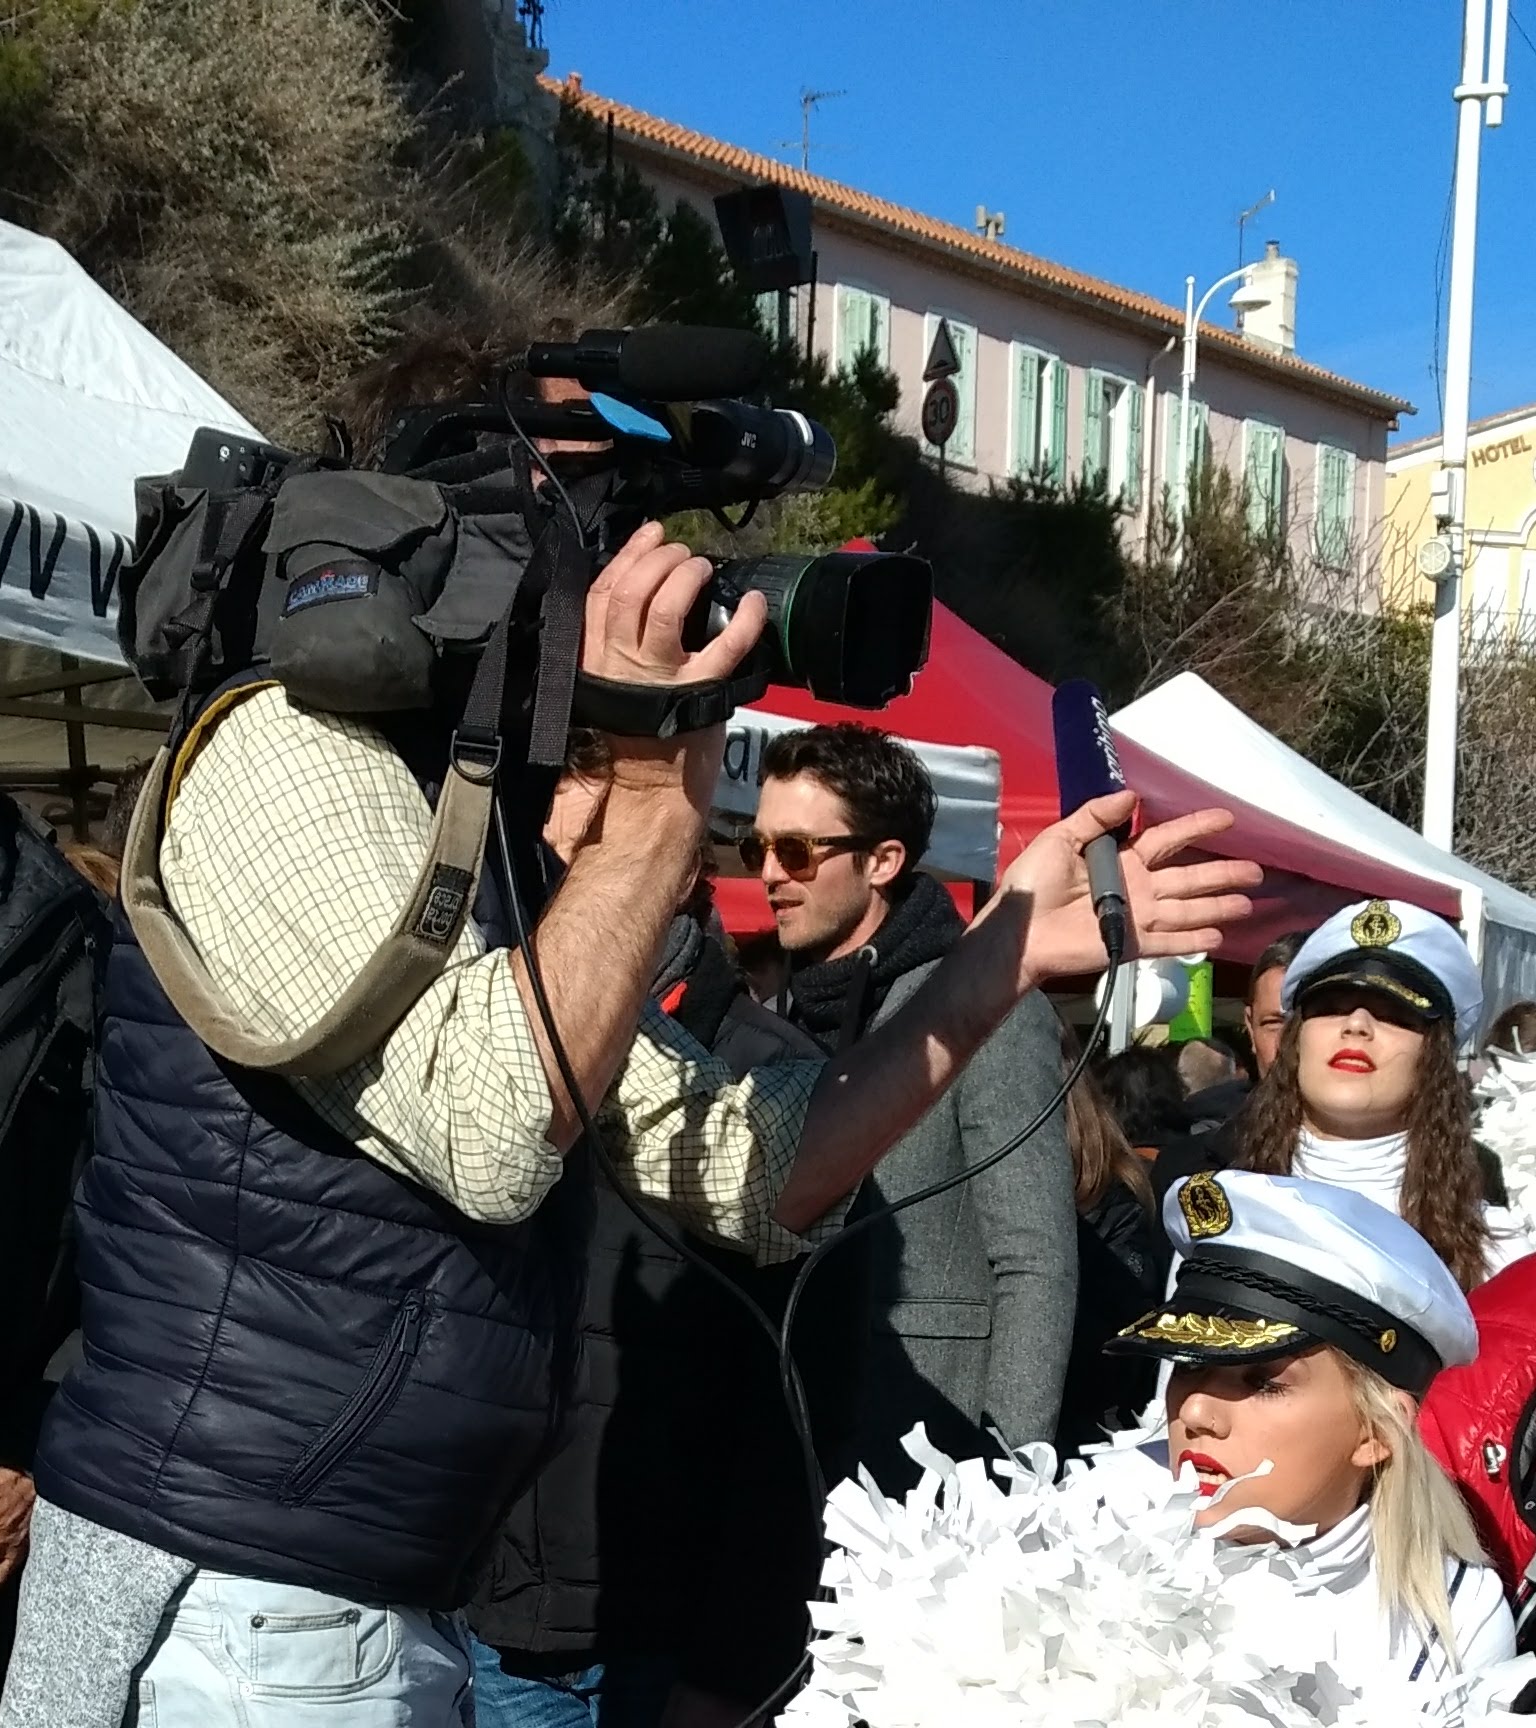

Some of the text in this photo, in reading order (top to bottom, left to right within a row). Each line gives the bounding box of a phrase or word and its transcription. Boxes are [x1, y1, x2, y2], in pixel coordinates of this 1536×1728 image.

[929, 396, 950, 427] 30
[740, 431, 757, 449] JVC
[1471, 434, 1532, 468] HOTEL
